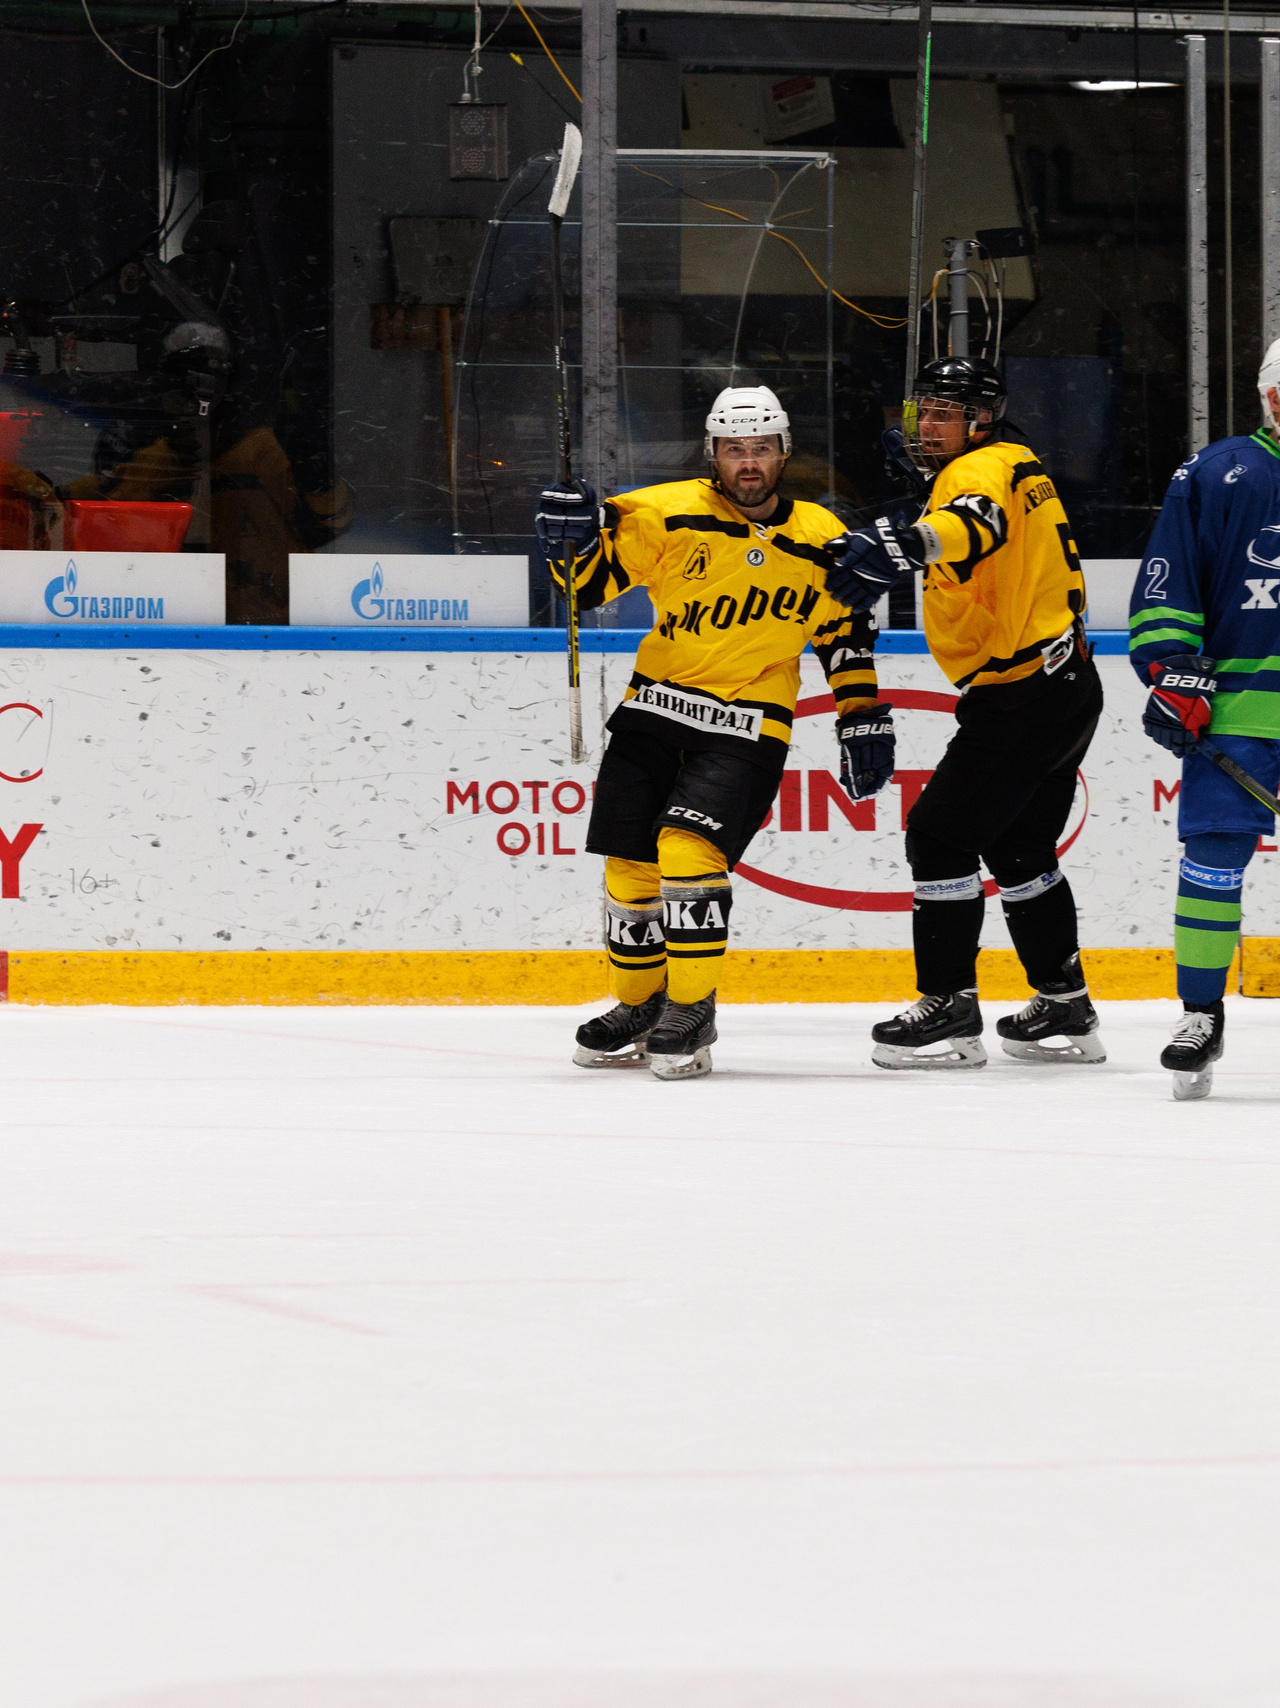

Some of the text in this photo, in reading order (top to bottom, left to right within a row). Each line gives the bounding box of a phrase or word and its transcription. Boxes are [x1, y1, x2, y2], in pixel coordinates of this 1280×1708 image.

[875, 516, 912, 571] AUER
[1145, 558, 1170, 599] 2
[80, 596, 164, 620] ГАЗПРОМ
[384, 599, 469, 621] ГАЗПРОМ
[1161, 674, 1217, 693] BAU
[446, 780, 597, 815] MOTO
[667, 806, 723, 831] CCM
[497, 821, 576, 856] OIL
[69, 867, 115, 895] 16+
